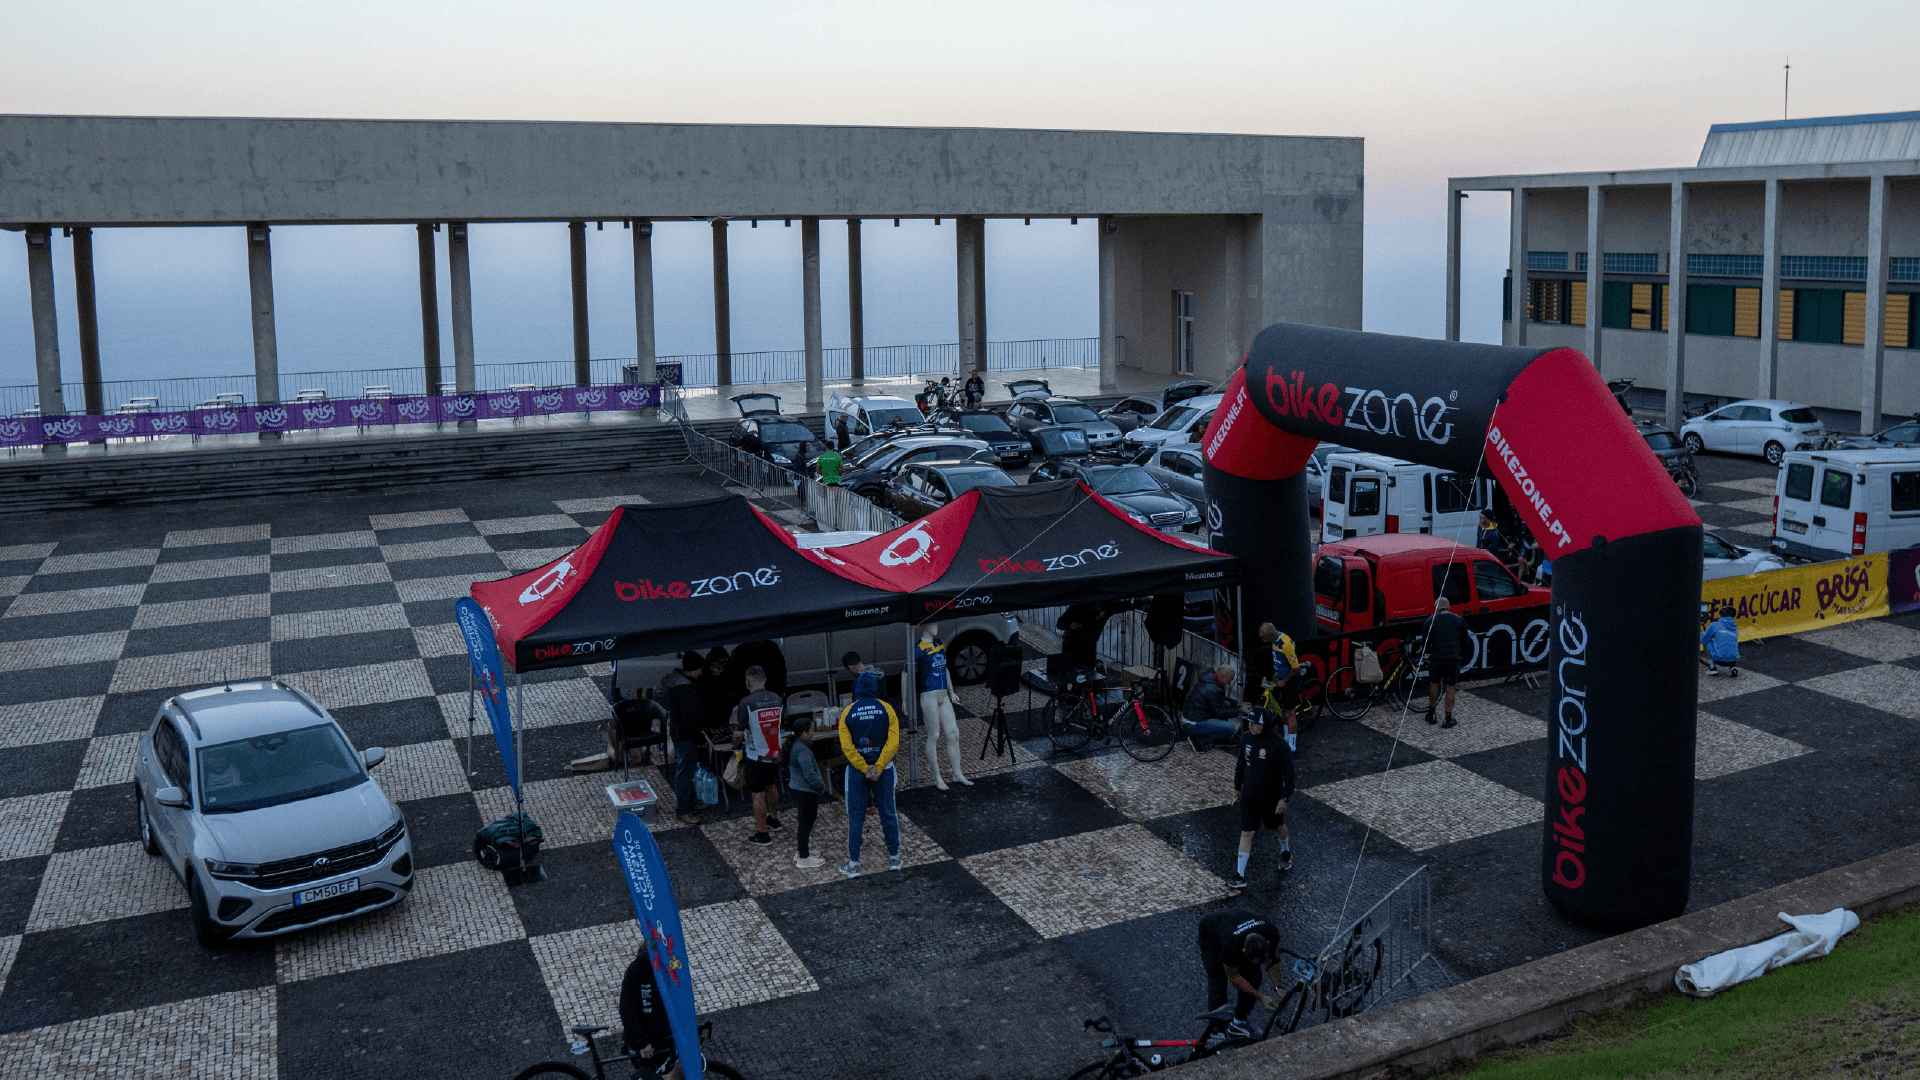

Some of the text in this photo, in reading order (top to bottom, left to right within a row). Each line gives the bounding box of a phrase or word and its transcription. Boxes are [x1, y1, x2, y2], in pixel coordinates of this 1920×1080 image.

[1266, 365, 1457, 445] bikezone
[1206, 386, 1248, 460] BIKEZONE.PT
[1489, 426, 1572, 548] BIKEZONE.PT
[978, 541, 1121, 574] bikezone
[614, 566, 781, 601] bikezone
[1185, 571, 1224, 581] bikezone.pt
[845, 605, 890, 618] bikezone.pt
[925, 594, 992, 613] bikezone
[1736, 585, 1801, 624] AÇÚCAR
[534, 638, 616, 660] bikezone
[1176, 664, 1187, 690] 2
[1552, 606, 1588, 889] bikezone
[304, 880, 355, 902] CM50EF
